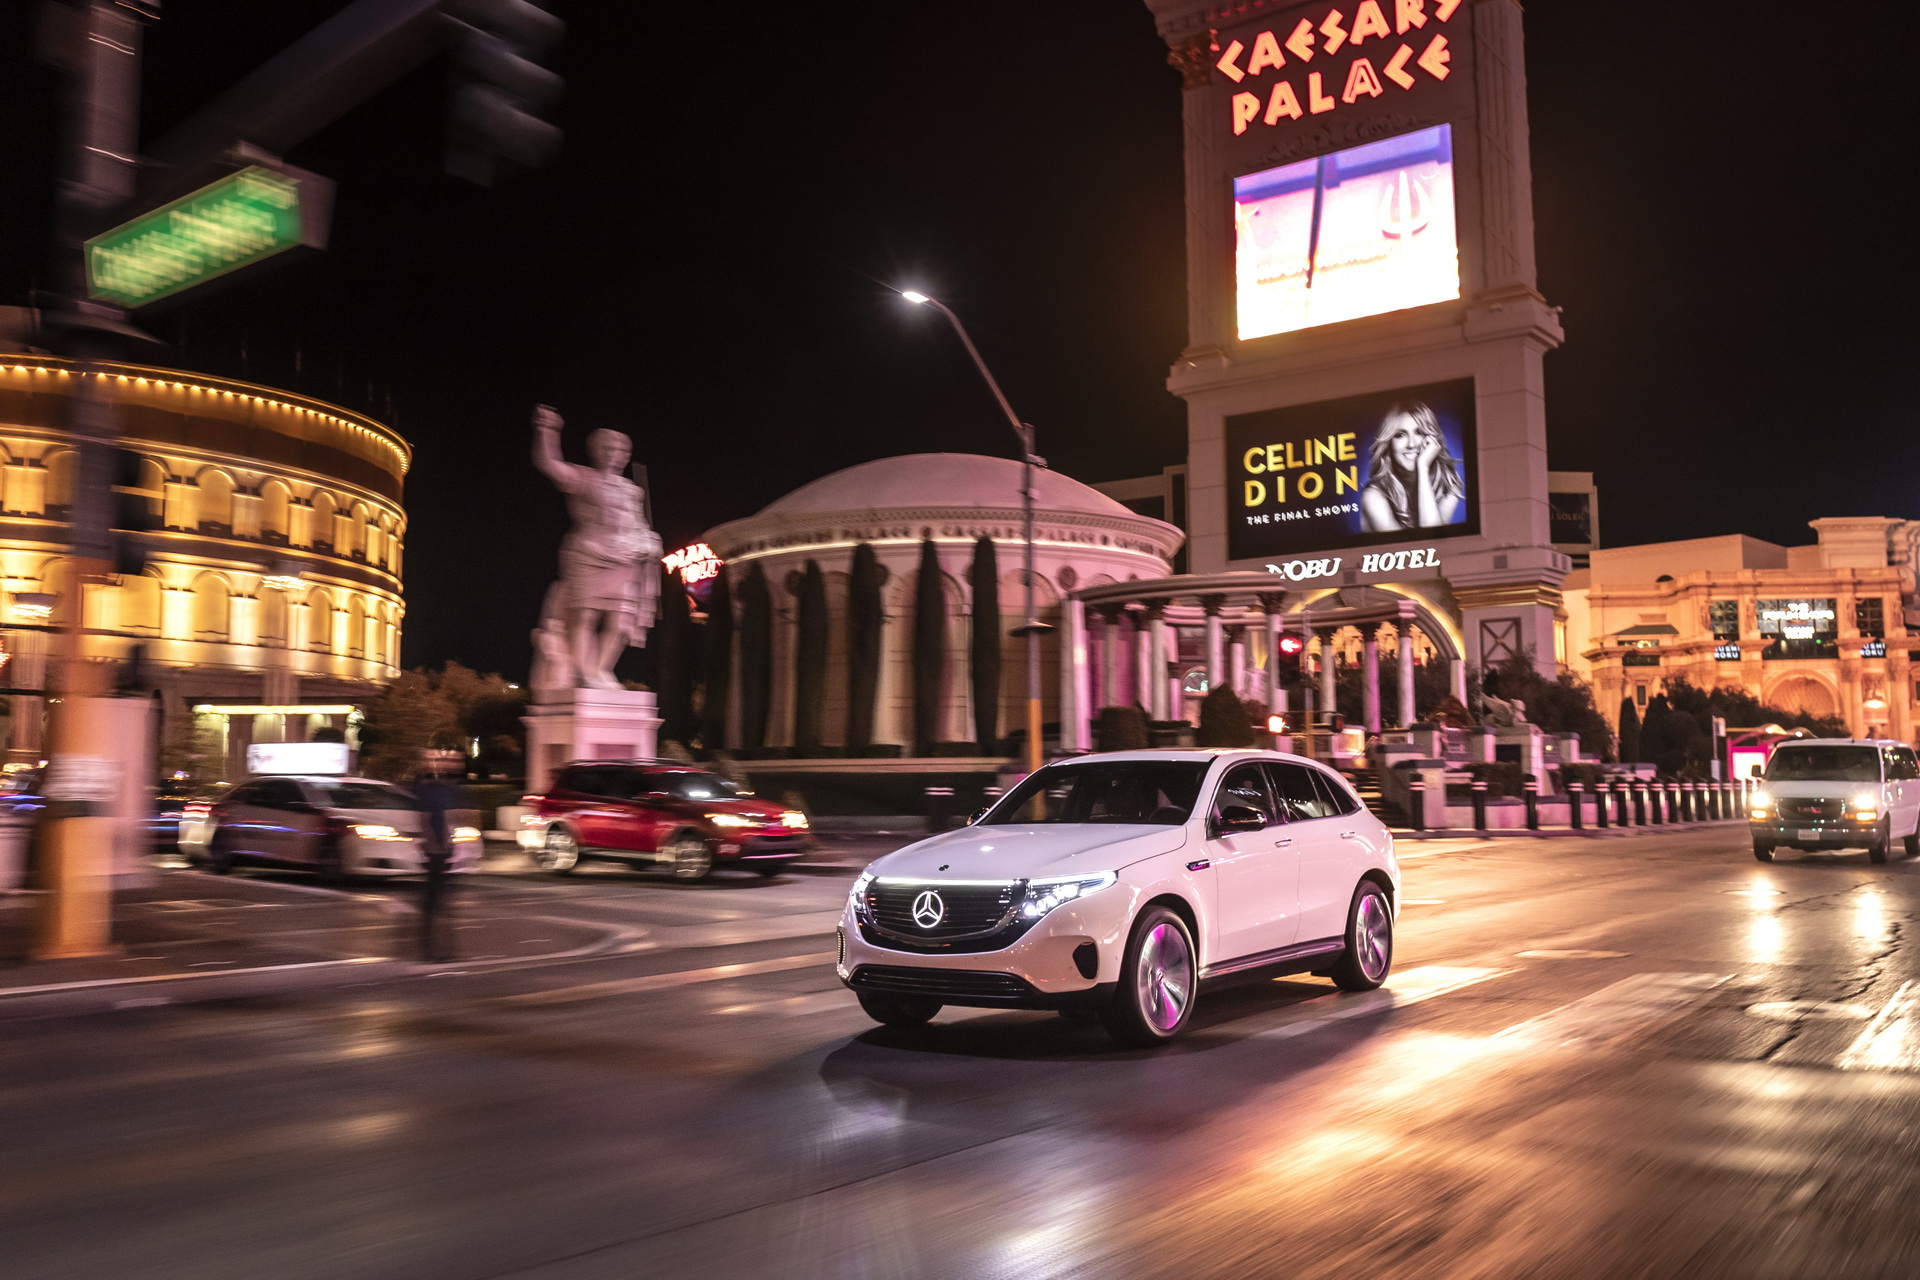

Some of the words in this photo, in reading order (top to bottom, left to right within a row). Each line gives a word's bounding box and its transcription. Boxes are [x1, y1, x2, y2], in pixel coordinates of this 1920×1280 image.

[1232, 33, 1450, 136] PALACE
[1243, 432, 1357, 475] CELINE
[1244, 465, 1358, 507] DION
[1246, 514, 1270, 526] THE
[1274, 508, 1311, 523] FINAL
[1315, 502, 1359, 517] SHOWS
[1361, 548, 1441, 573] HOTEL
